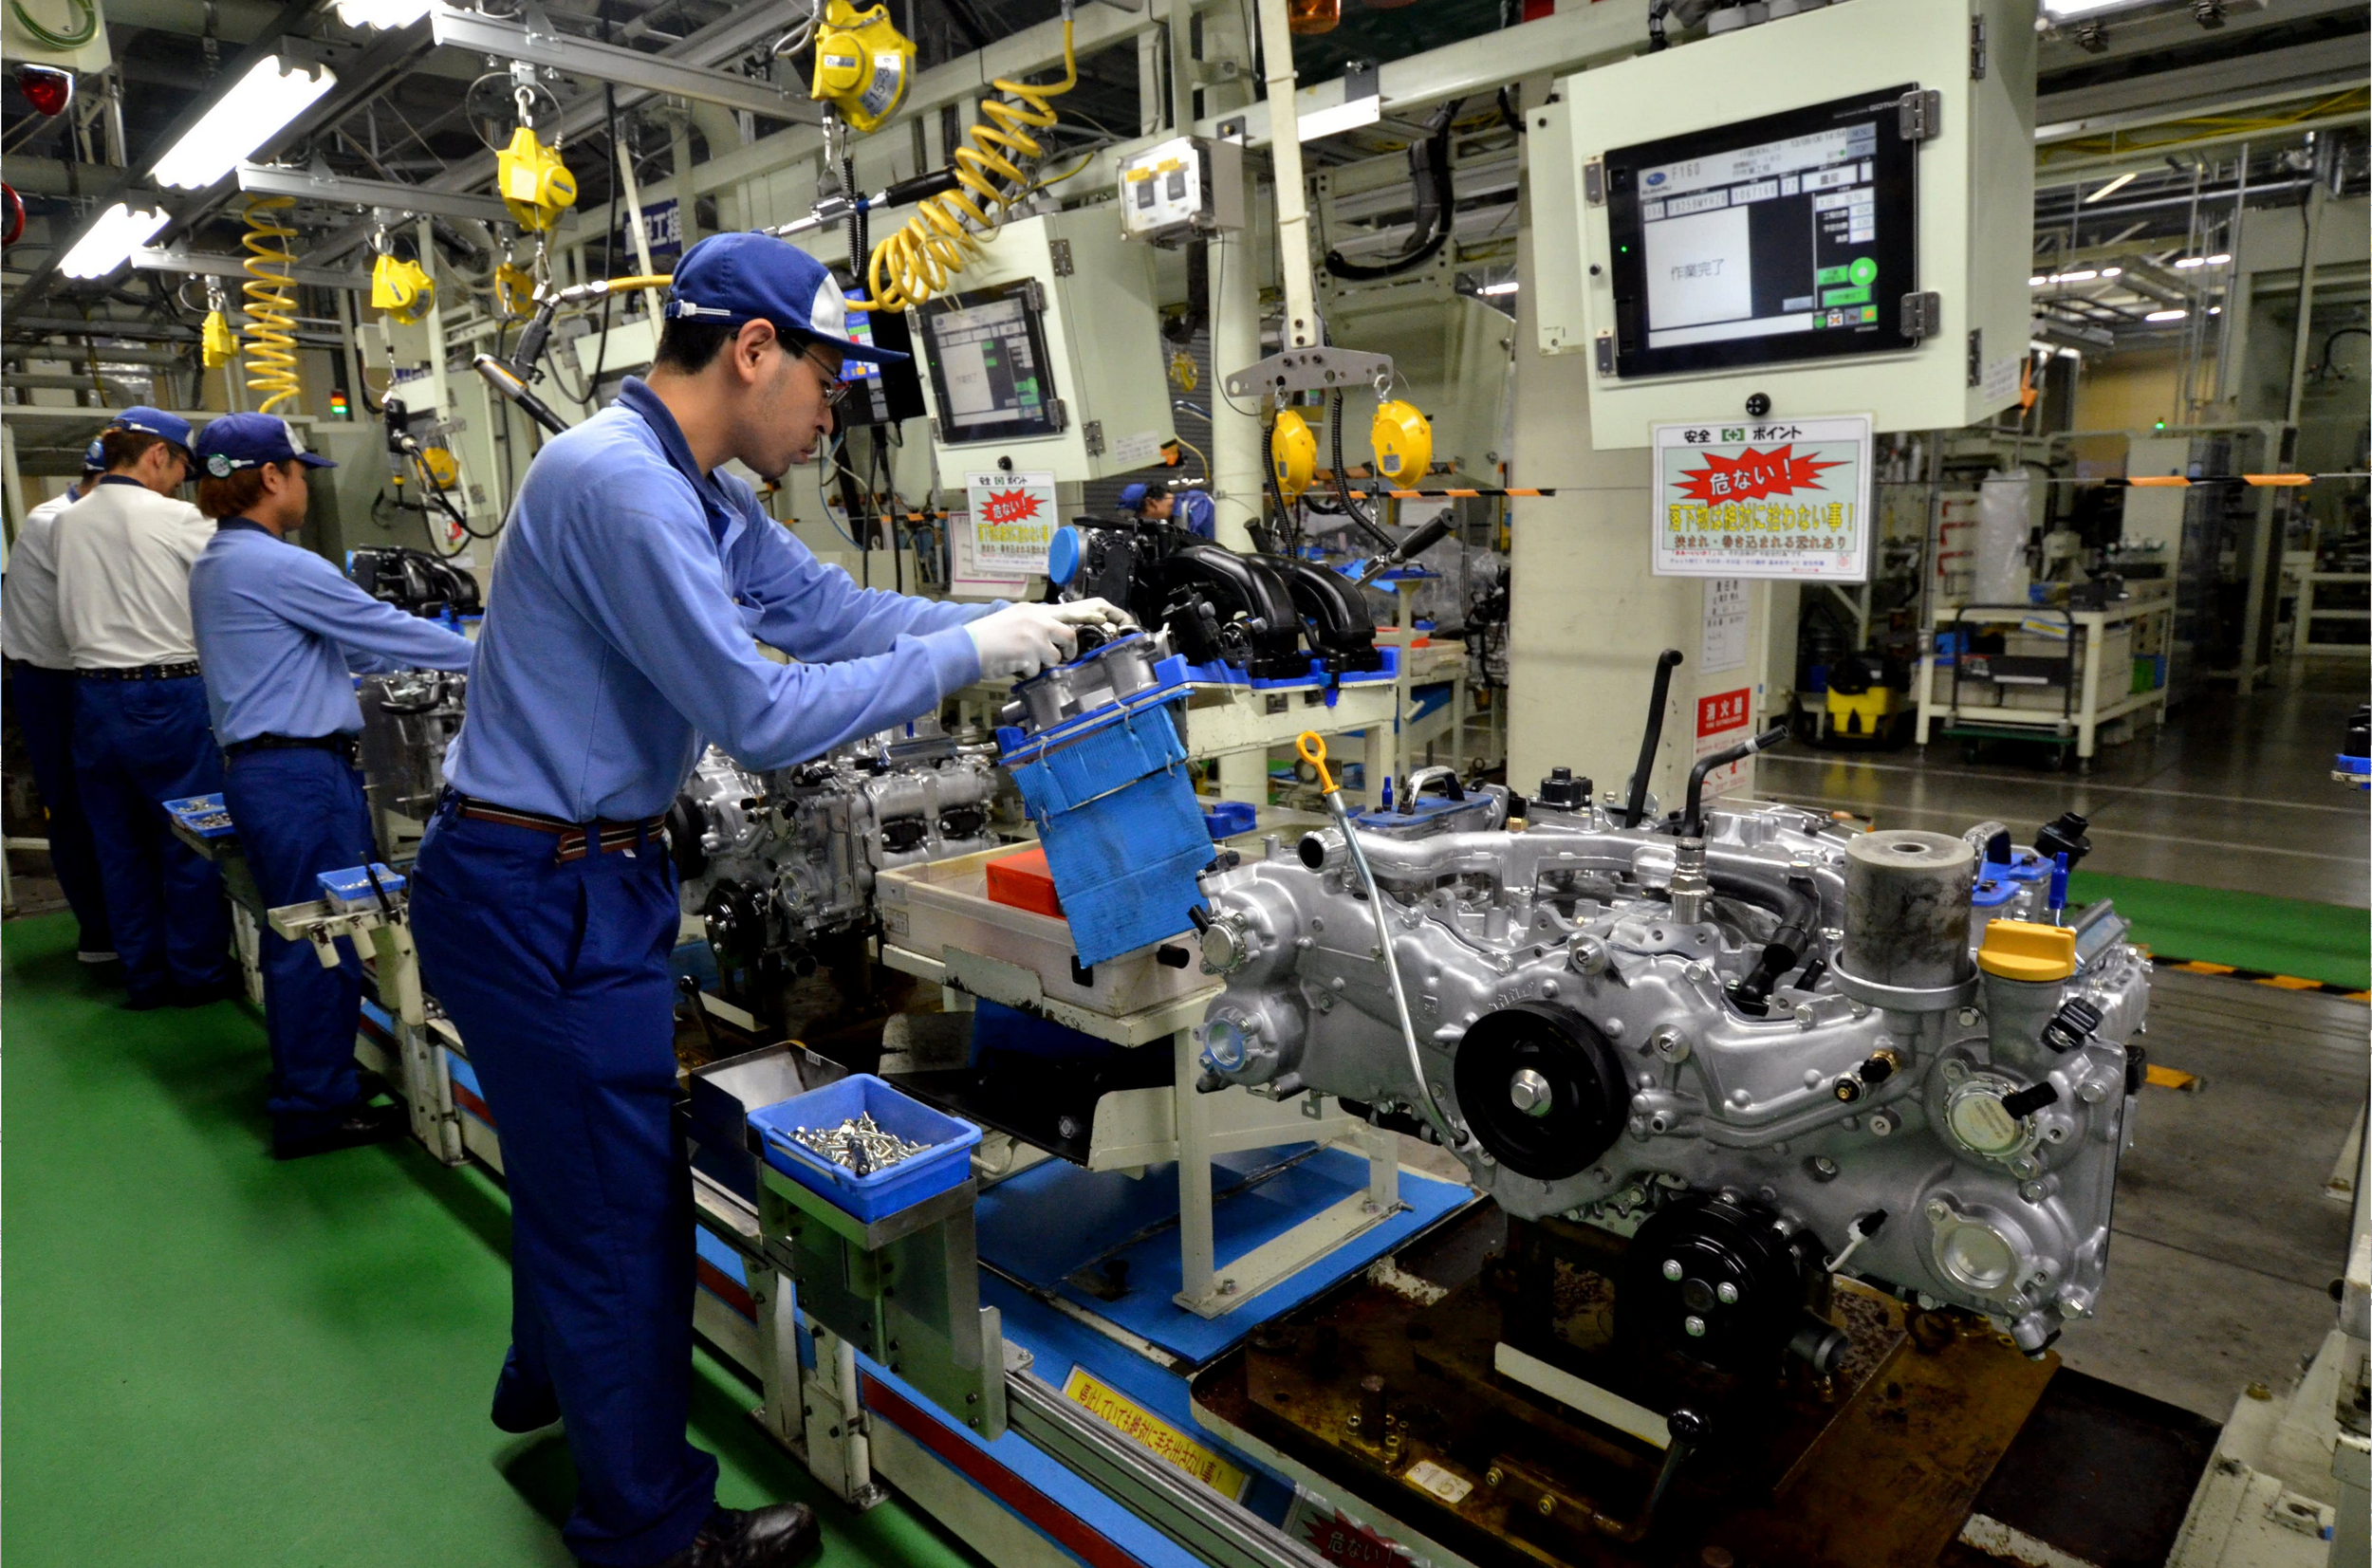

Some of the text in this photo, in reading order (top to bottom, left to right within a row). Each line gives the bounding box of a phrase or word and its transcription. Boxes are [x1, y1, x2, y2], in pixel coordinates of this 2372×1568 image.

[1671, 258, 1725, 282] 作業完了
[1684, 426, 1802, 444] 安全 ポイント
[1710, 459, 1791, 496] 危ない！
[992, 496, 1028, 519] 危ない！
[1668, 502, 1854, 532] 落下物は絶対に拾わない事！
[1706, 696, 1743, 721] 消火器
